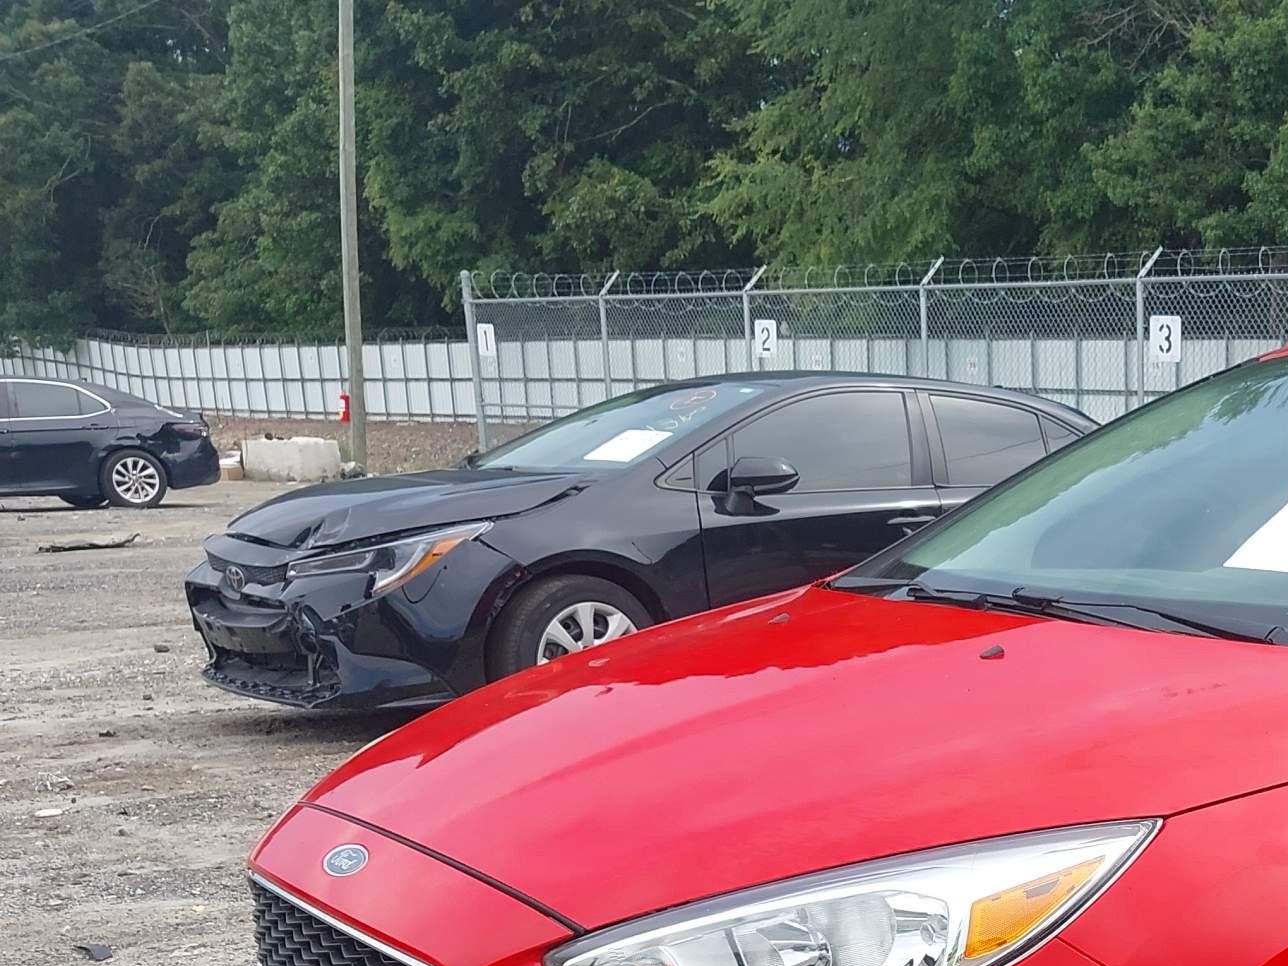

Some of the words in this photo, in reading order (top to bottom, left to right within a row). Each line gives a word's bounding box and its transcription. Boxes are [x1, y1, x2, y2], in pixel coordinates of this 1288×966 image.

[483, 329, 489, 352] 1
[761, 327, 771, 352] 2
[1159, 323, 1172, 354] 3
[330, 849, 358, 870] Ford
